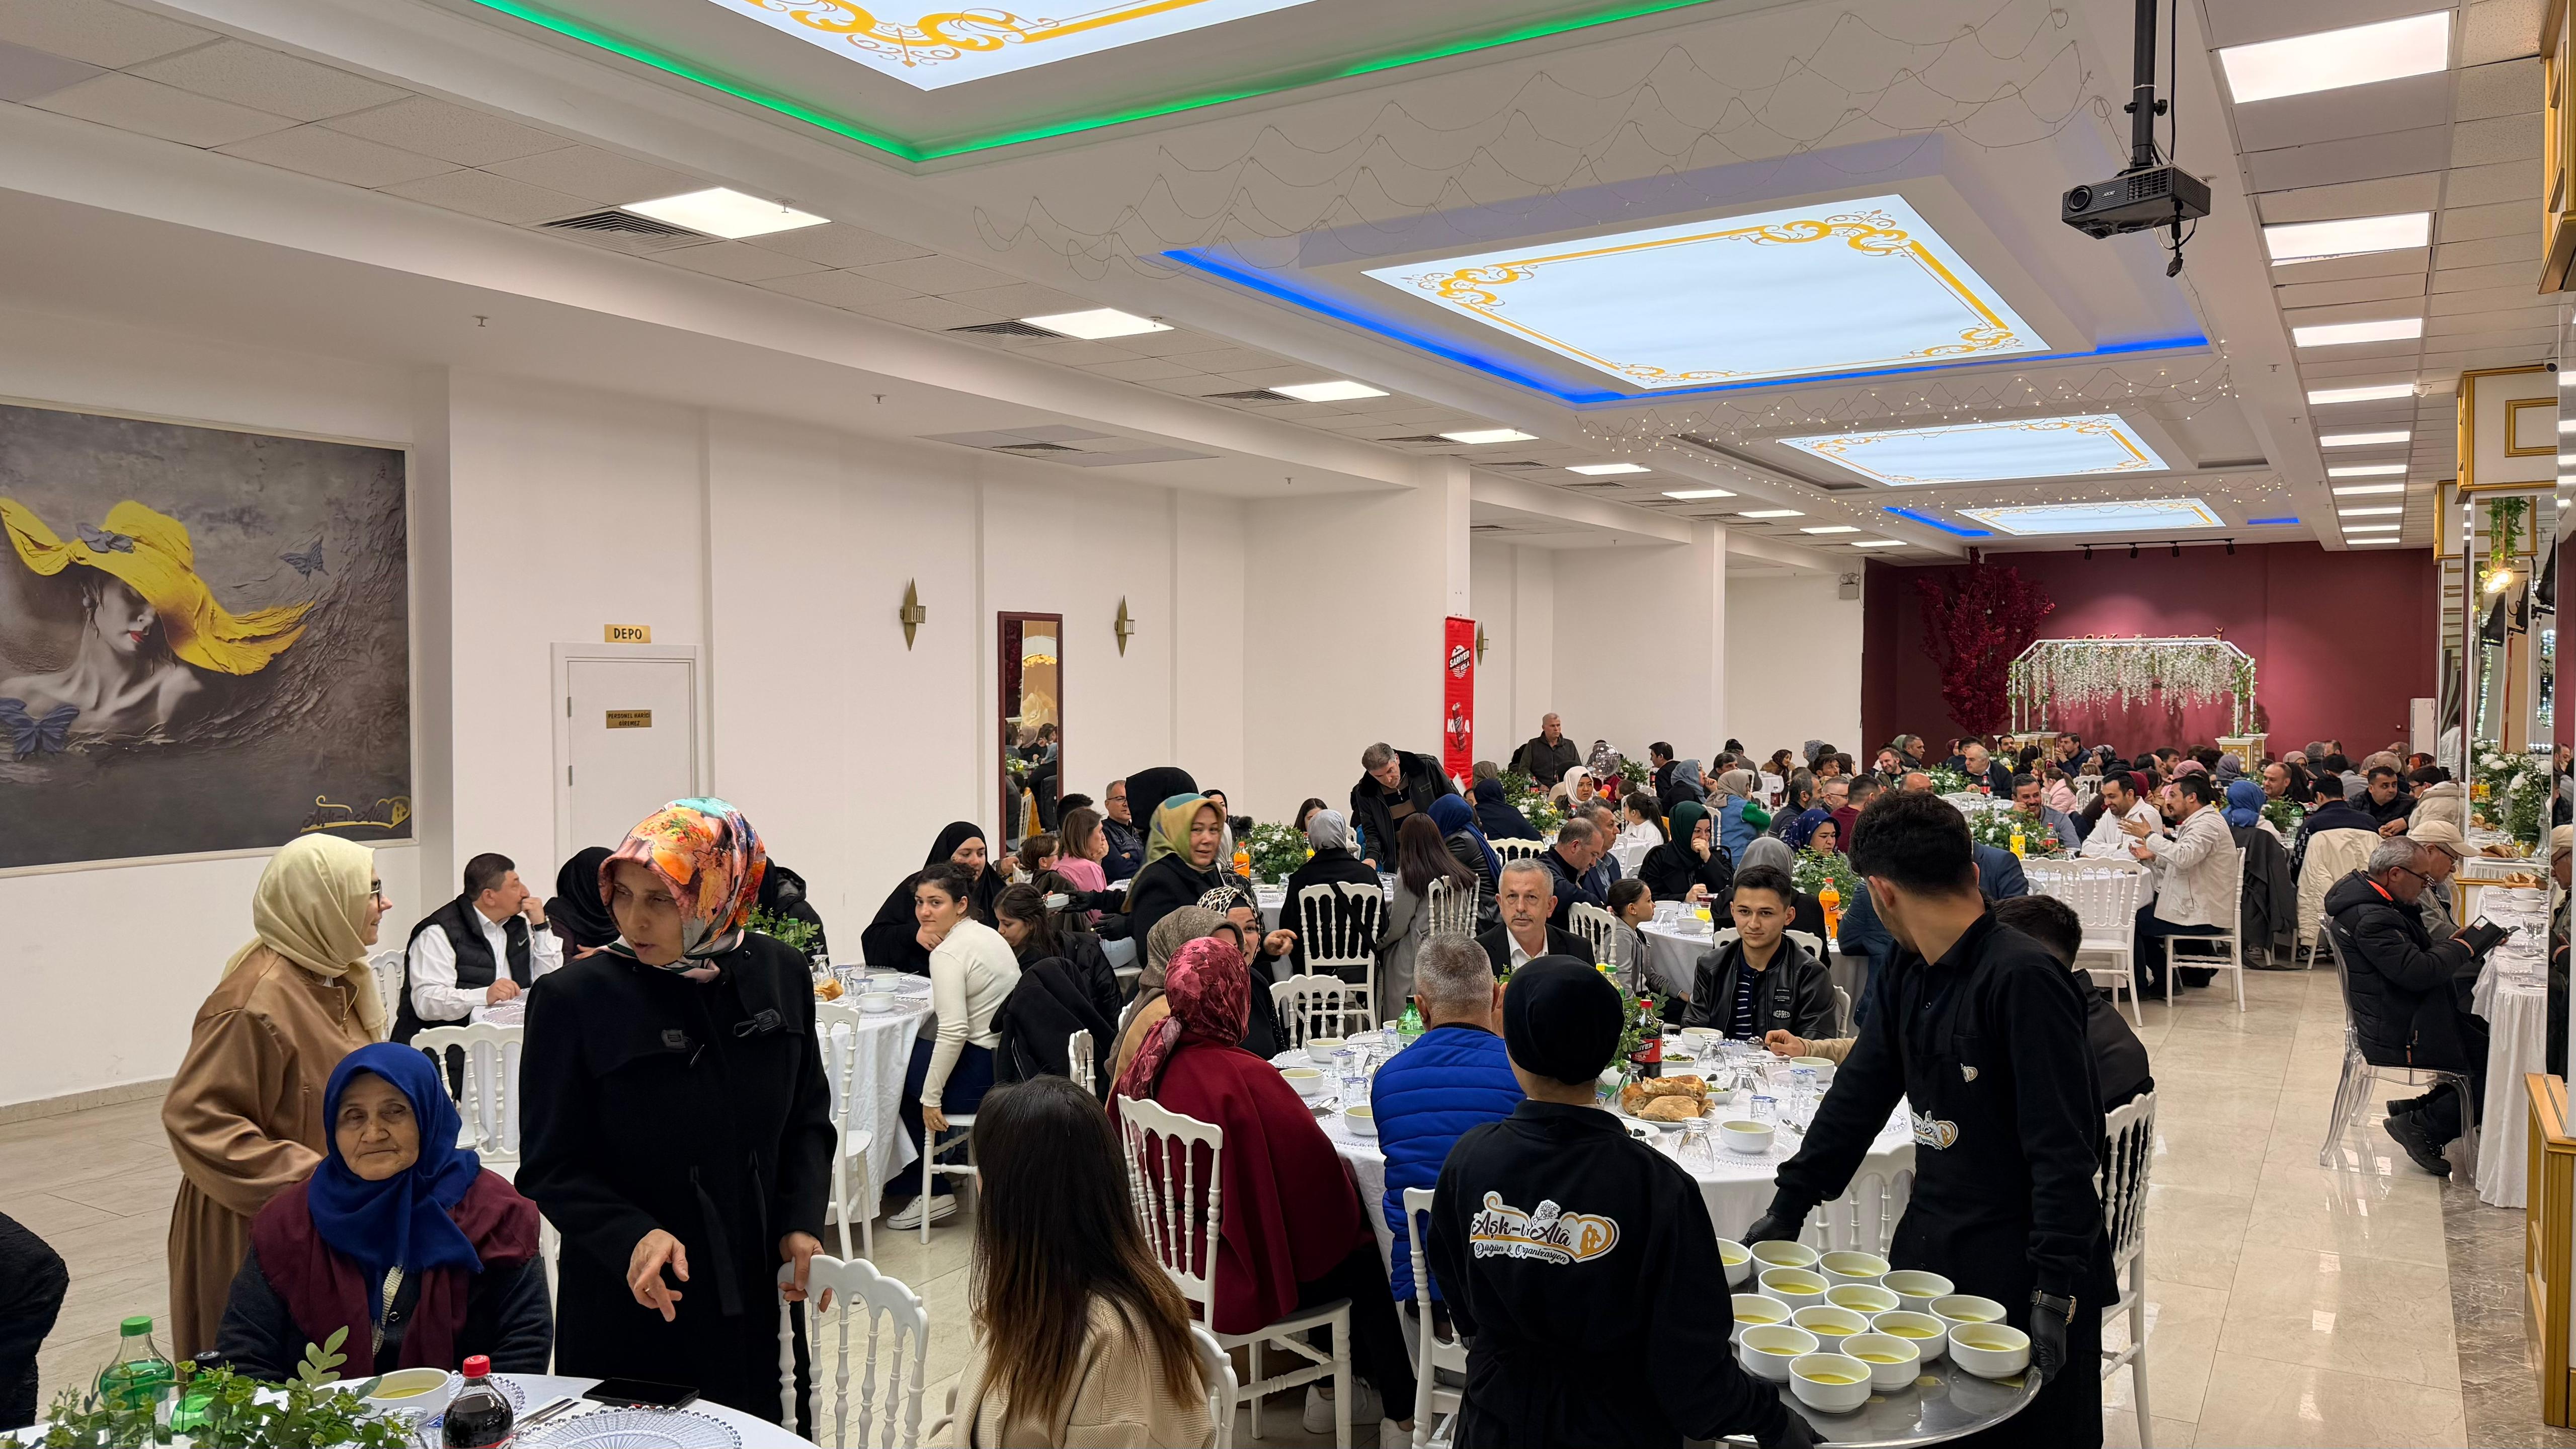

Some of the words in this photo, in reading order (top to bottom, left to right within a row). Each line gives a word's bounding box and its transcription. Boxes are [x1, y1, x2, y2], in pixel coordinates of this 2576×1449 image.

[614, 627, 642, 639] DEPO
[1447, 718, 1470, 733] KA
[1529, 1222, 1571, 1246] Alâ
[1475, 1243, 1505, 1257] Düğün
[1515, 1244, 1568, 1263] Organizasyon
